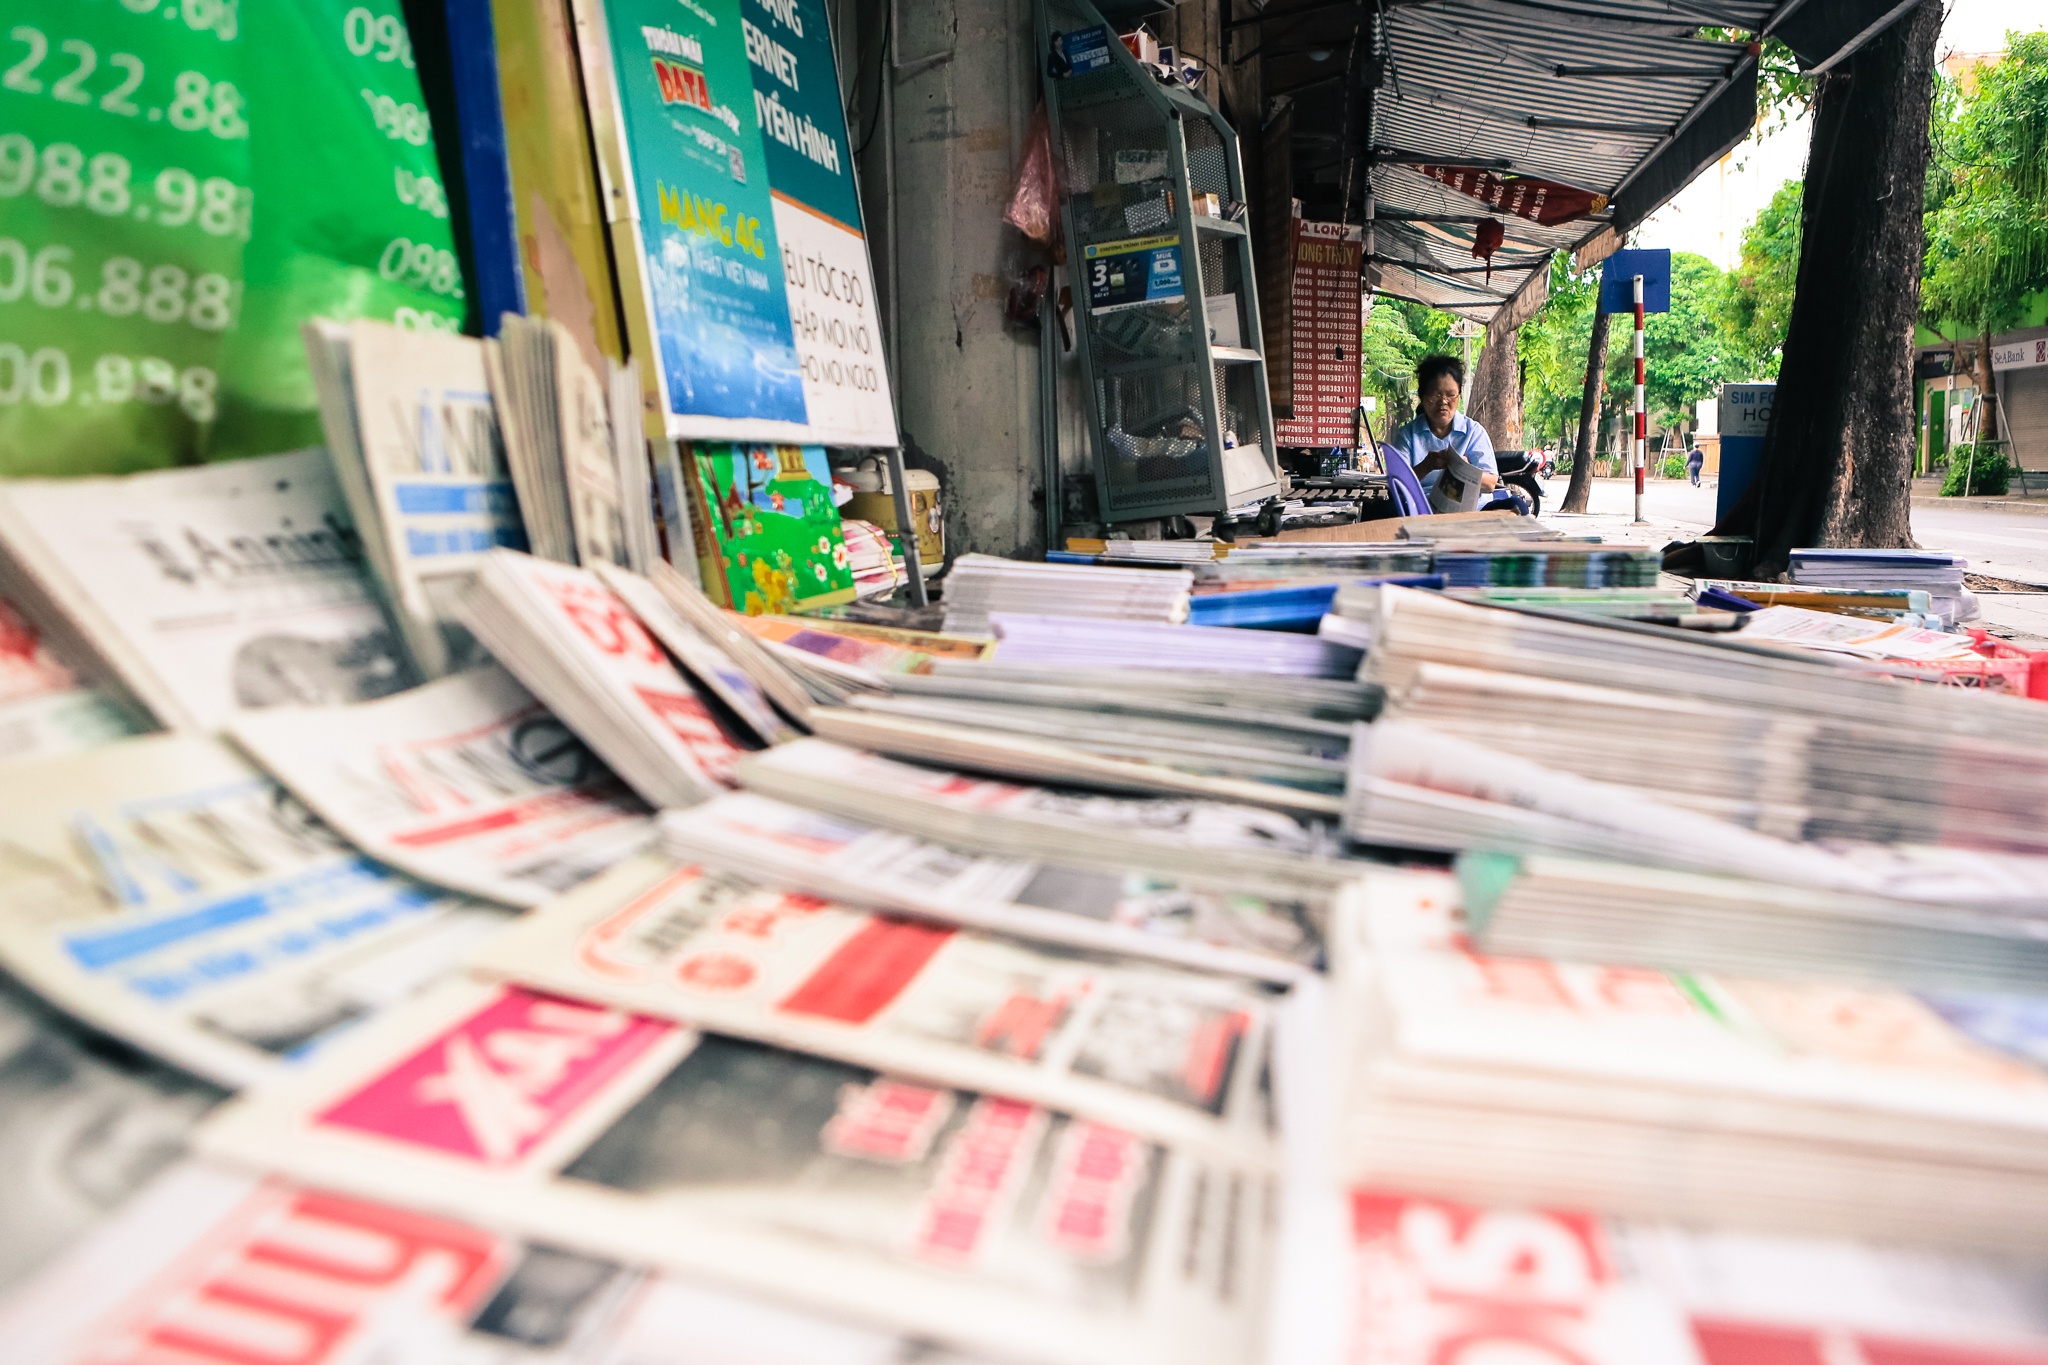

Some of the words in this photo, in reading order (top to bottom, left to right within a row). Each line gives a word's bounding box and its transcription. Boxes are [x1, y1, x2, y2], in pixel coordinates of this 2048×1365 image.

[741, 17, 800, 93] ERNET
[735, 212, 766, 260] 4G
[1092, 264, 1108, 287] 3
[1994, 347, 2025, 365] SeABank
[1731, 391, 1755, 405] SIM
